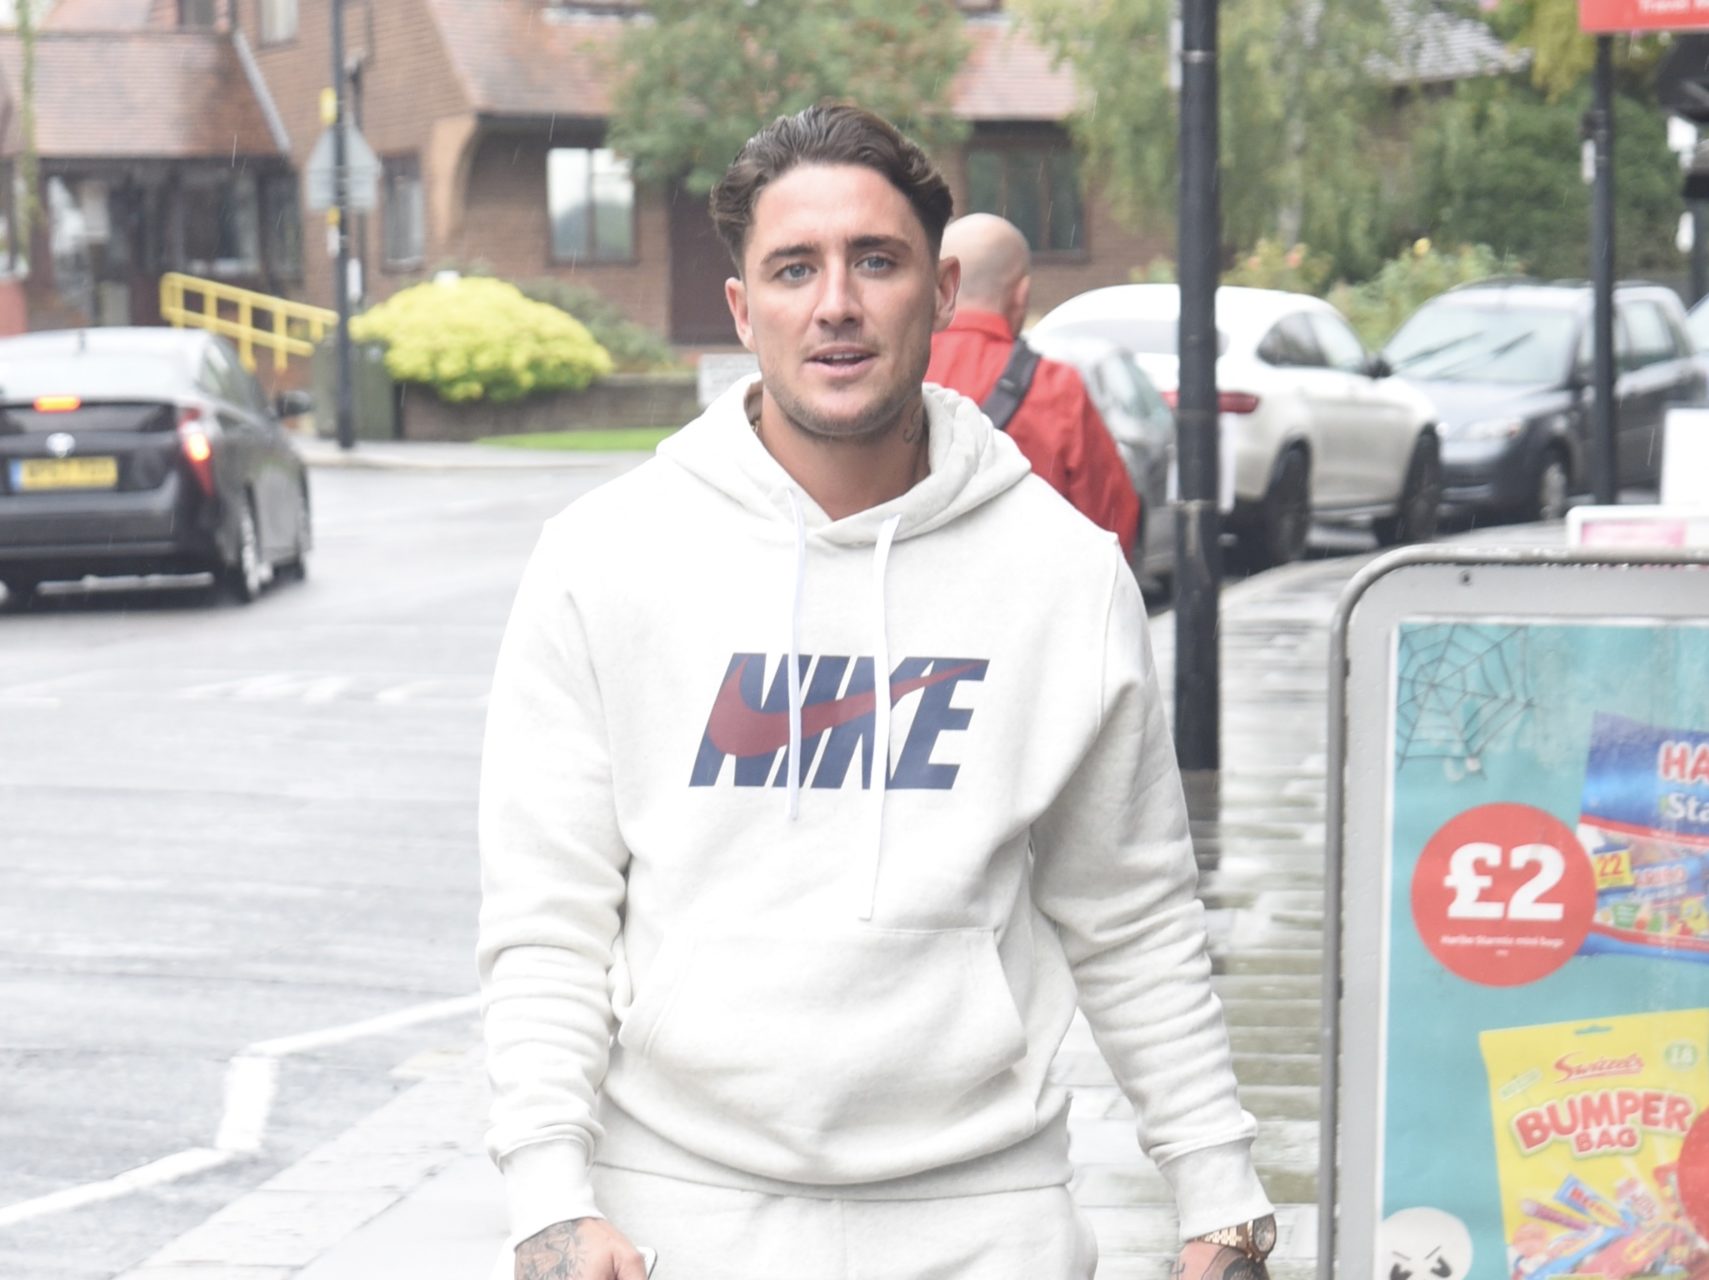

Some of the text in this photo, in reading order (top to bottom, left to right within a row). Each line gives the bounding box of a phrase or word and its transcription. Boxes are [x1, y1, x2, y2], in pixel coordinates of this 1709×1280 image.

[688, 652, 990, 790] NIKE
[1444, 842, 1566, 921] £2
[1514, 1090, 1694, 1151] BUMPER
[1575, 1127, 1638, 1153] BAG
